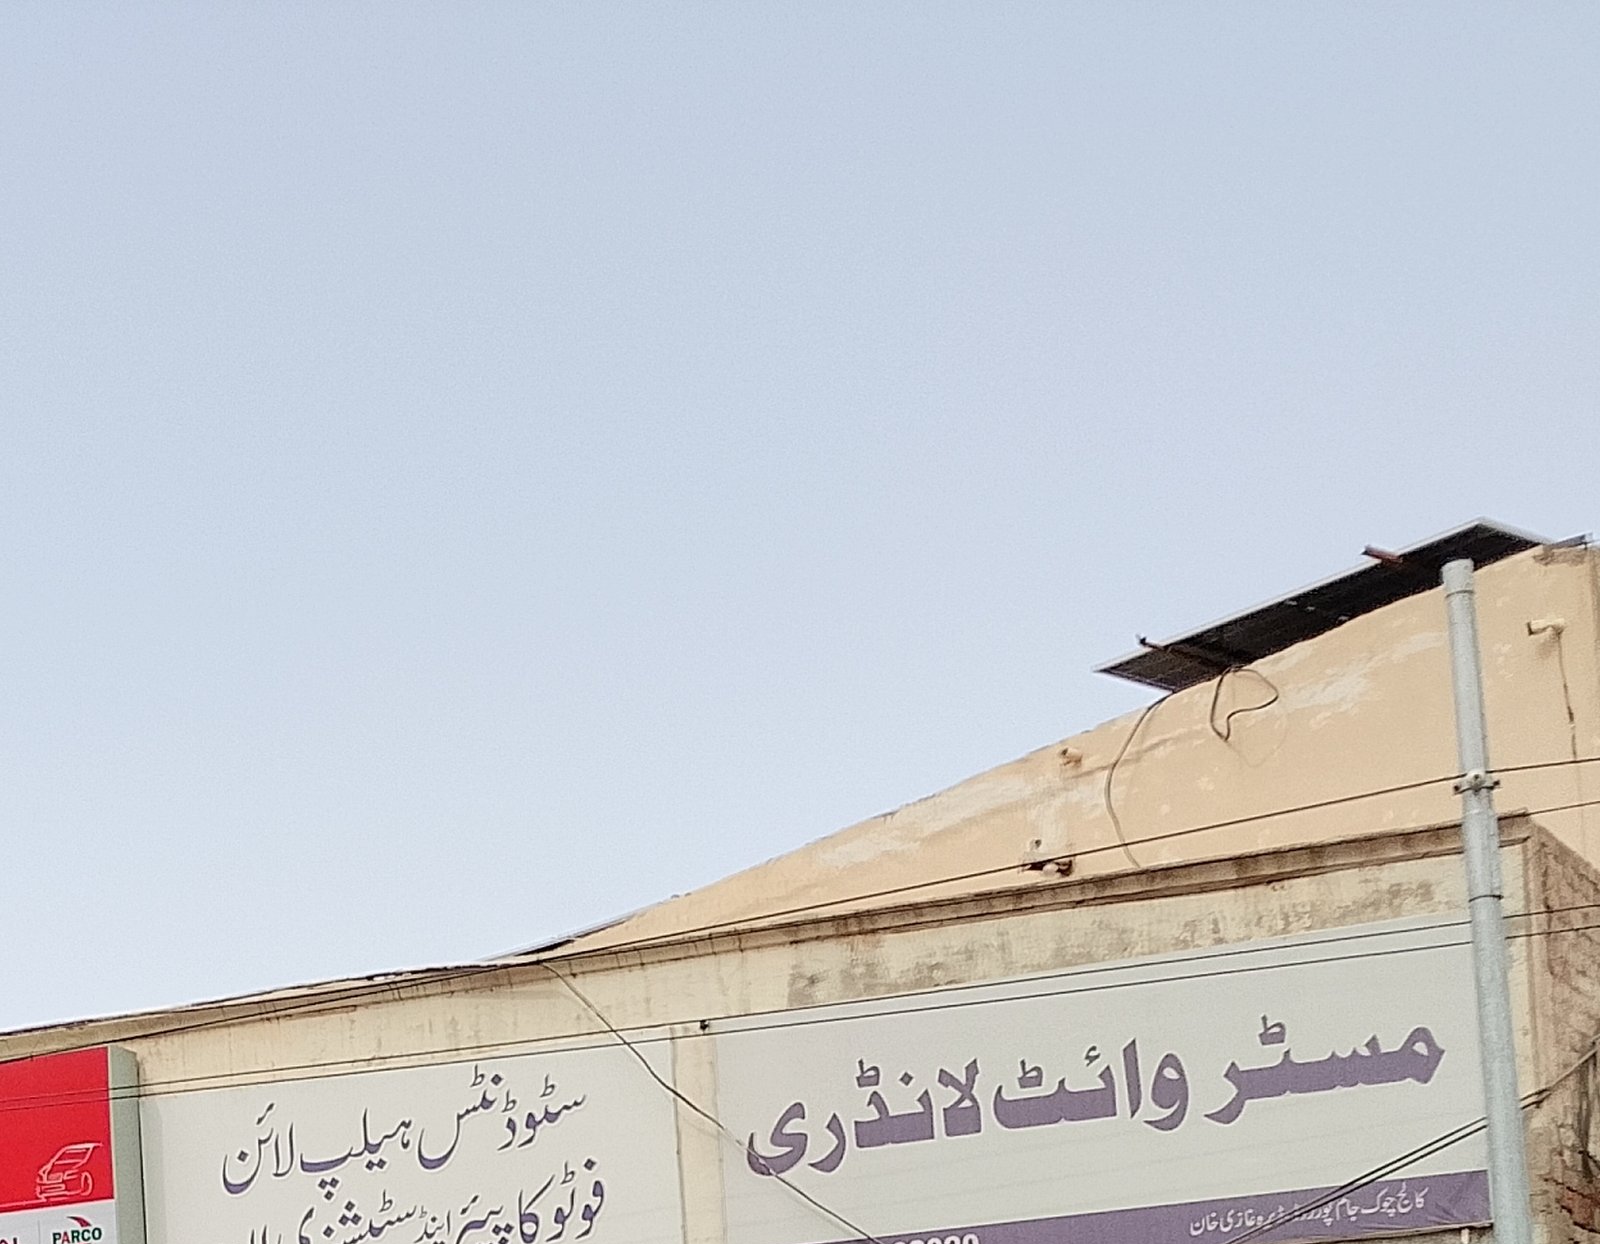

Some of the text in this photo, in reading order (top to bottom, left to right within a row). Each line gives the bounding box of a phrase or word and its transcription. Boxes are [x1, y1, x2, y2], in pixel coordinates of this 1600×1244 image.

[222, 1064, 587, 1200] سٹوڈنٹس ہیلپ لائن
[747, 1014, 1445, 1176] مسٹر وائٹ لانڈری
[546, 1158, 604, 1242] فوٹو
[1361, 1187, 1396, 1217] چوک
